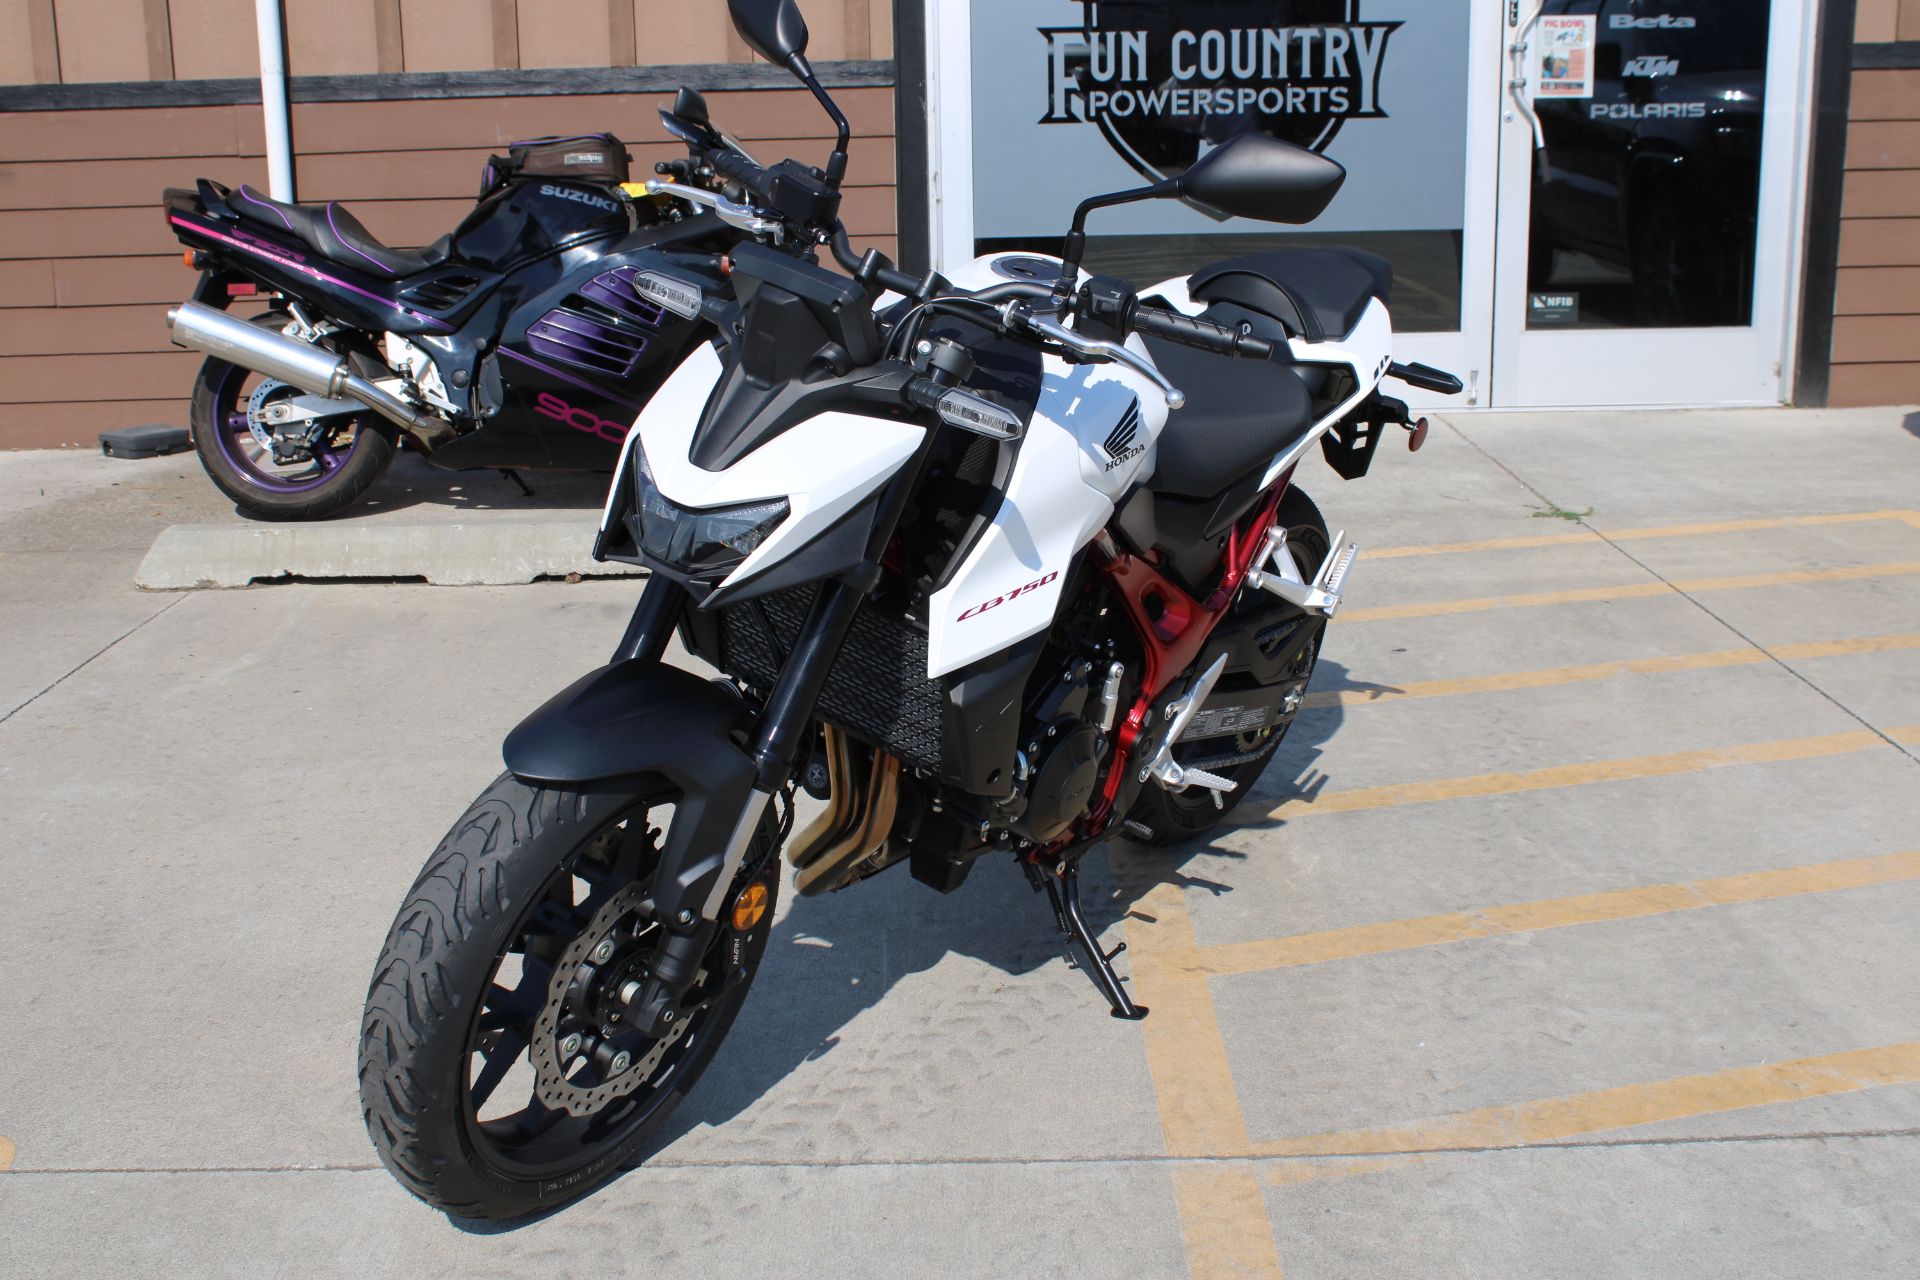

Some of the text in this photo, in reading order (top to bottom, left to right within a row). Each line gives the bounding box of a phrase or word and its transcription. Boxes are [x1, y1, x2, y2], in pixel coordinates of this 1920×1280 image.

[1609, 14, 1696, 28] Beta
[1050, 26, 1393, 118] FUN COUNTRY
[1622, 56, 1679, 76] KTM
[1089, 86, 1350, 117] POWERSPORTS
[1590, 102, 1706, 119] POLARIS
[540, 184, 618, 212] SUZUKI
[1105, 444, 1145, 472] HONDA
[957, 571, 1058, 622] CB750
